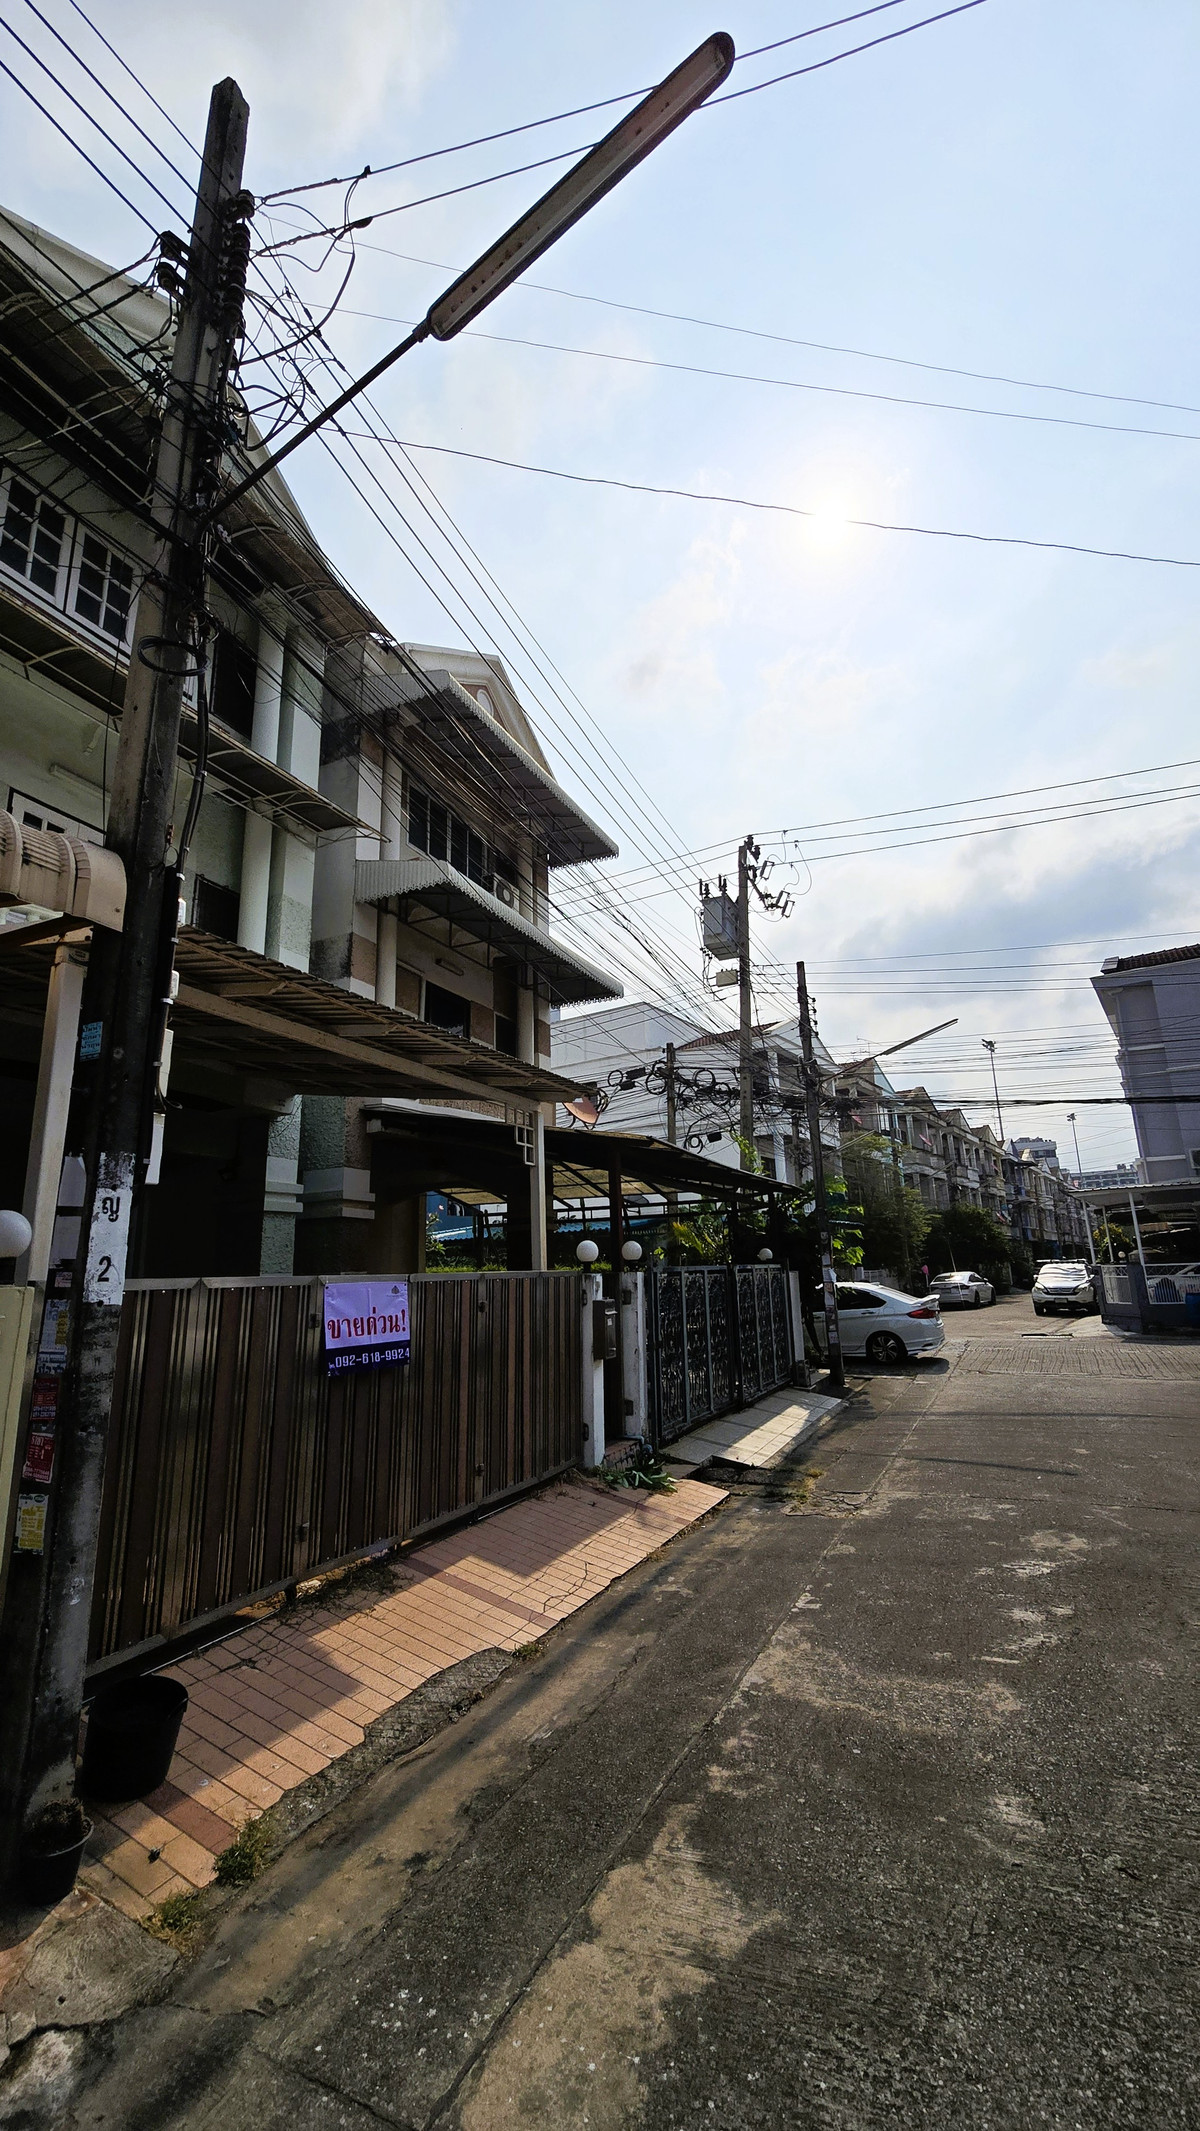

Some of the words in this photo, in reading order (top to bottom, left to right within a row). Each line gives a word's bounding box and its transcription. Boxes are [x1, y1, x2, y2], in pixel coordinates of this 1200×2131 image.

[101, 1196, 121, 1223] ญ
[97, 1255, 112, 1283] 2
[327, 1306, 406, 1339] ขายด่วน!
[335, 1347, 410, 1368] 092-618-9924
